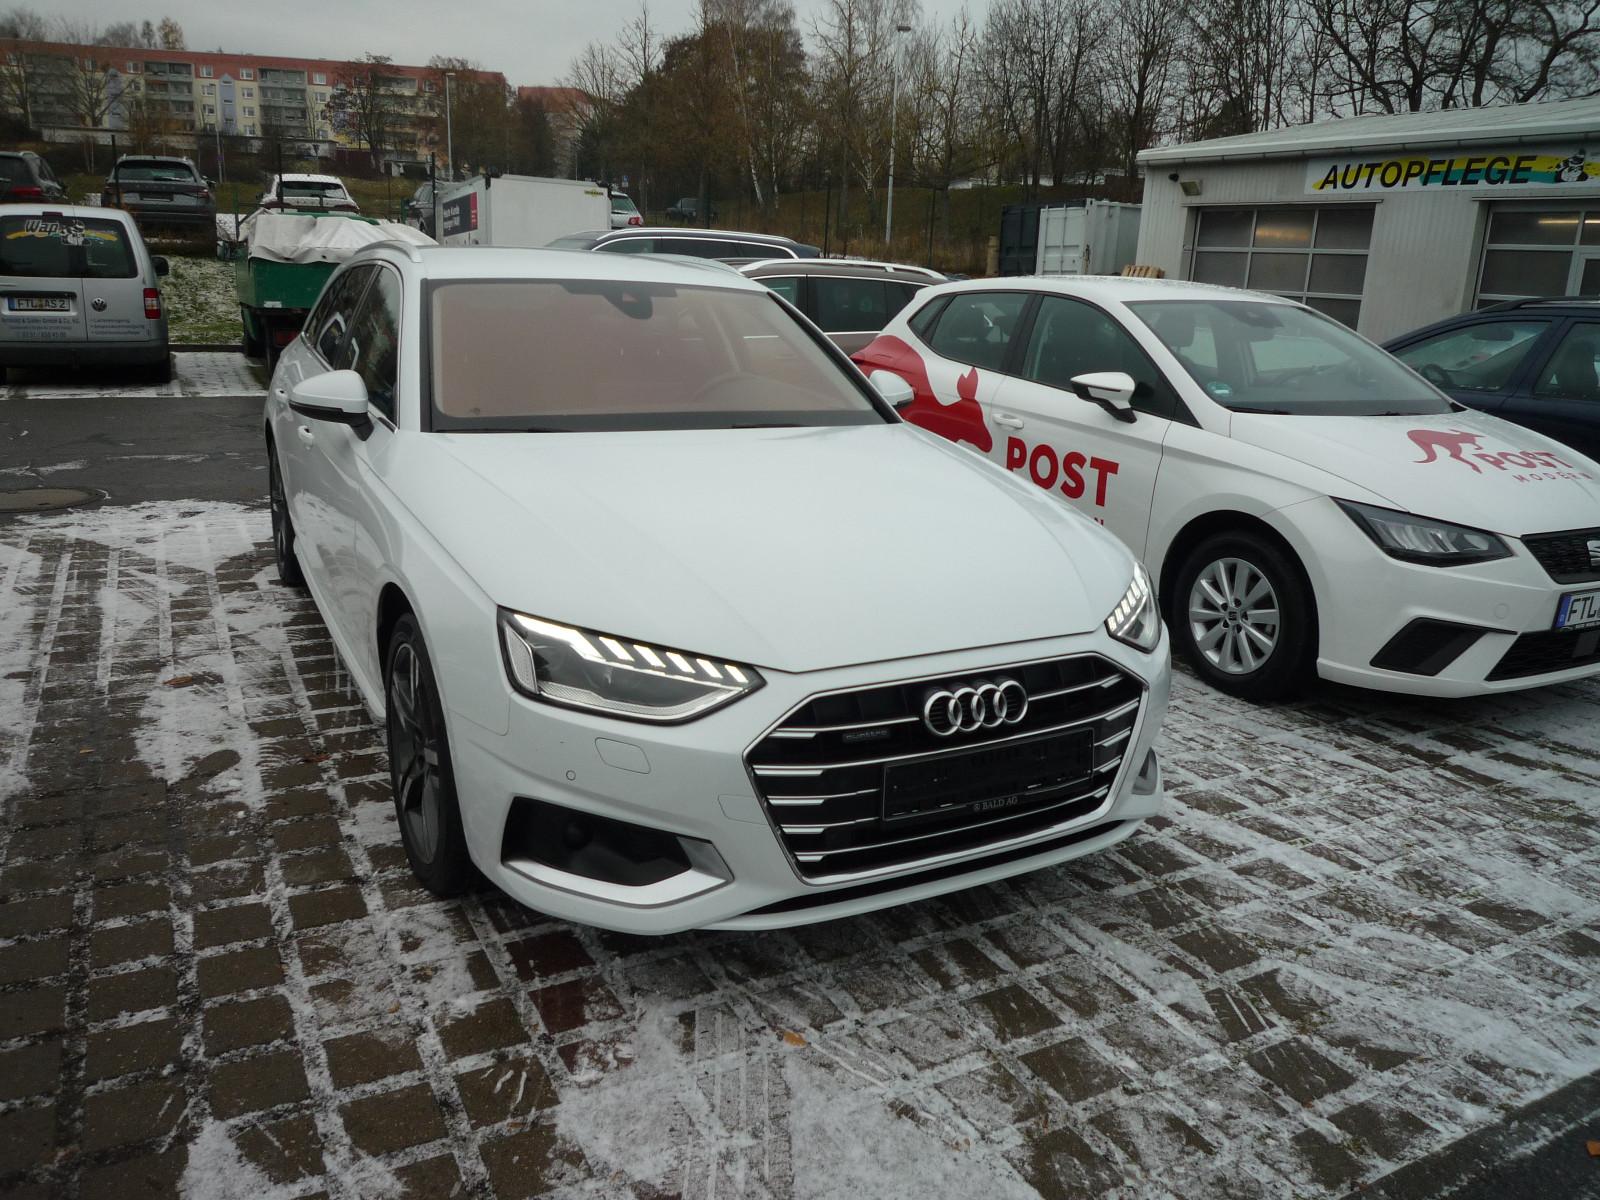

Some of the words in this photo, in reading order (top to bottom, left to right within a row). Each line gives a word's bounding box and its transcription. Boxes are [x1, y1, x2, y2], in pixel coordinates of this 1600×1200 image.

[1319, 155, 1537, 190] AUTOPFLEGE
[17, 298, 38, 309] FTL
[1006, 436, 1119, 507] POST
[1472, 451, 1573, 470] POST
[1567, 596, 1597, 622] FTL
